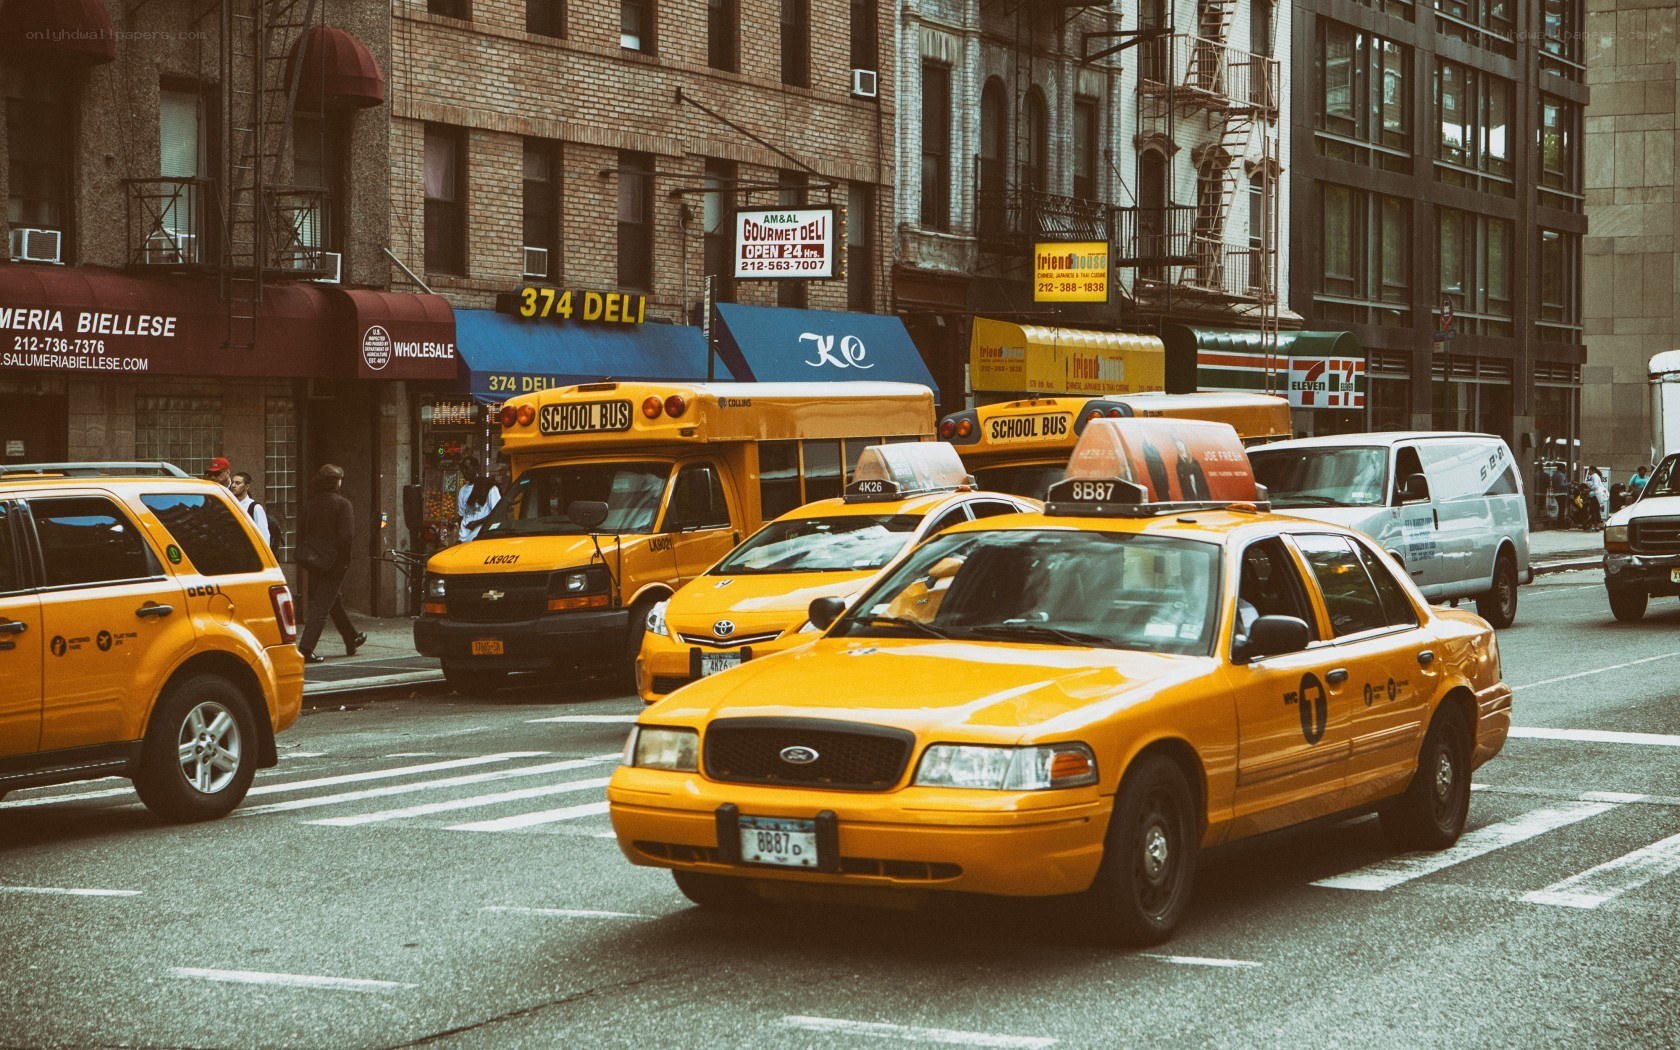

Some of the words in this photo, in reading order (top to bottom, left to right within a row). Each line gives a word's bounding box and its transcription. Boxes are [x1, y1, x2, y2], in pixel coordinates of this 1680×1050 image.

[763, 214, 799, 223] AM&AL
[743, 218, 797, 241] GOURMET
[800, 216, 825, 240] DELI
[745, 245, 779, 258] OPEN
[783, 244, 802, 258] 24
[741, 260, 825, 270] 212-563-7007
[520, 287, 573, 319] 374
[583, 291, 646, 324] DELI
[77, 312, 177, 337] BIELLESE
[14, 336, 105, 354] 212-736-7376
[394, 342, 454, 358] WHOLESALE
[0, 353, 148, 370] .SALUMERIABIELLESE.COM
[489, 375, 516, 391] 374
[728, 399, 752, 407] COLLINS
[541, 404, 596, 432] SCHOOL
[600, 402, 628, 429] BUS
[992, 418, 1038, 439] SCHOOL
[1042, 416, 1067, 435] BUS
[1203, 450, 1218, 462] JOE
[858, 482, 882, 493] 4K26
[1072, 482, 1115, 500] 8B87
[484, 555, 520, 565] LK9021
